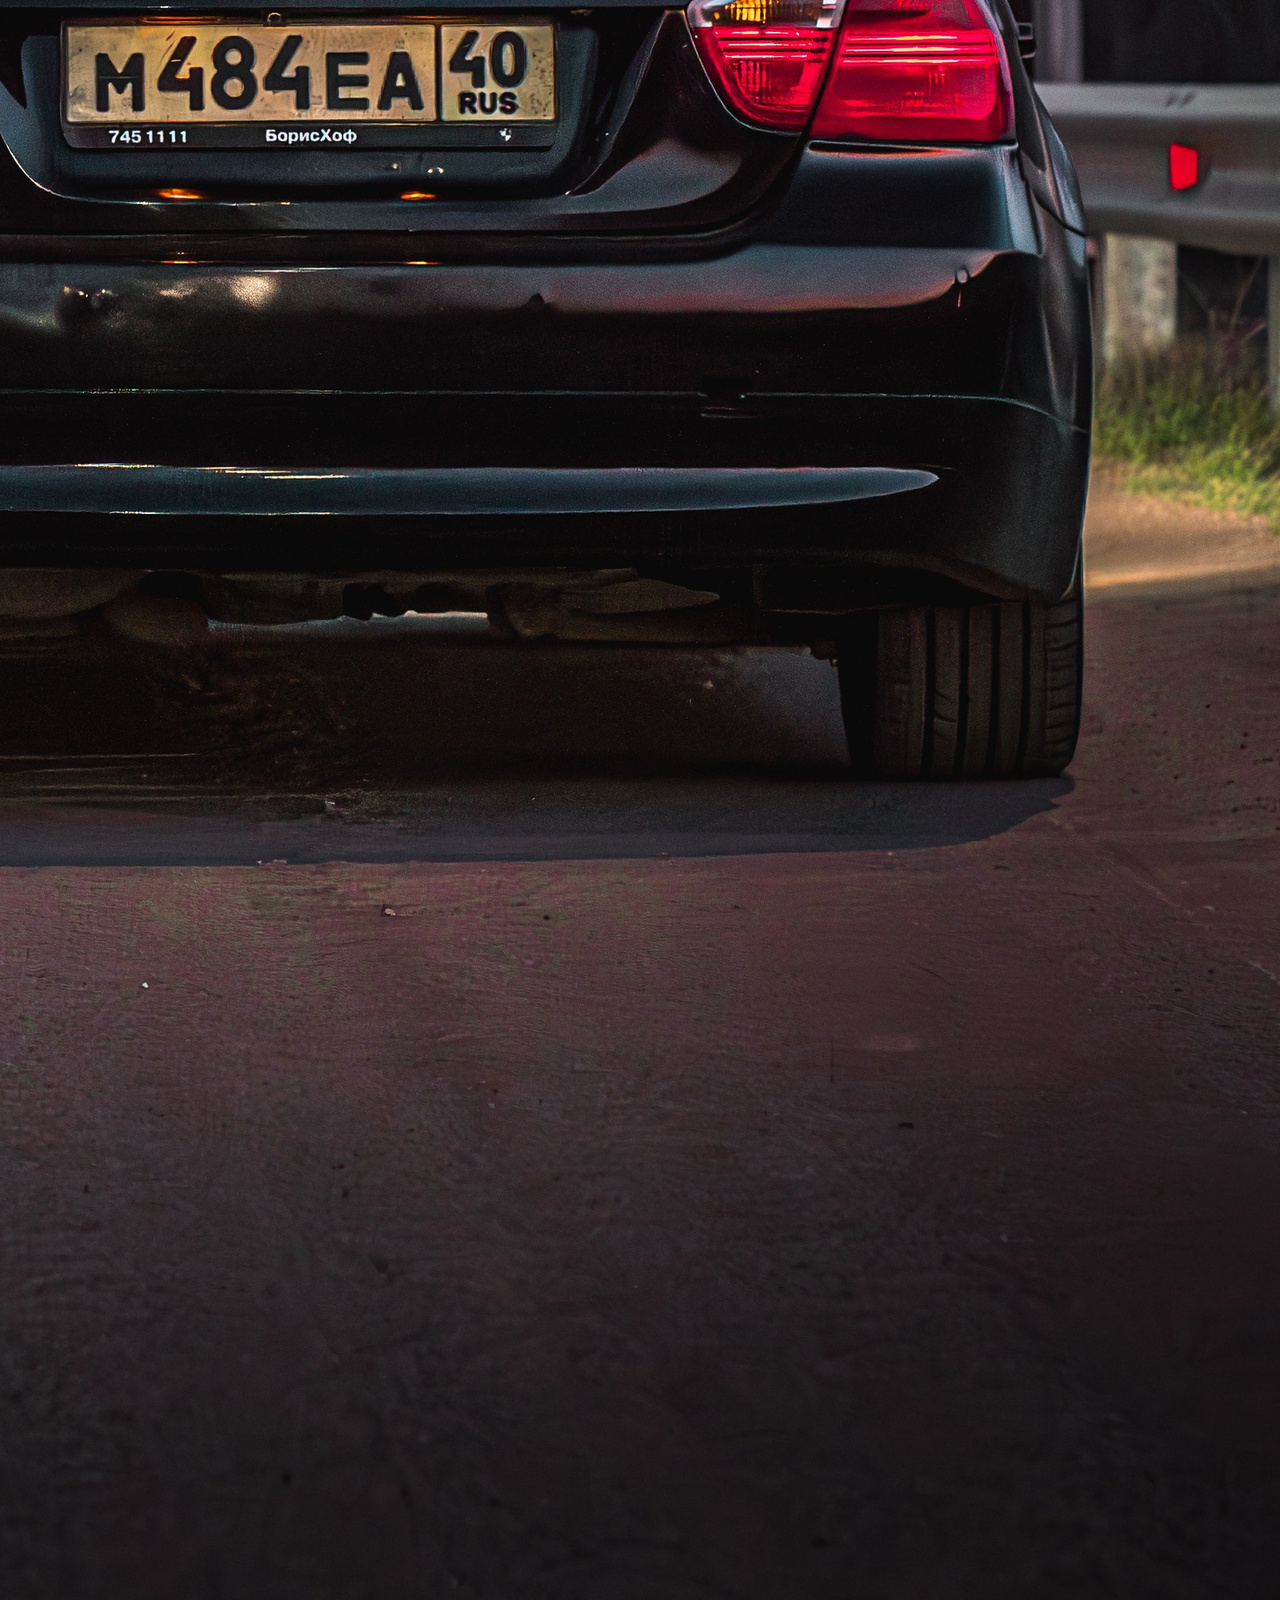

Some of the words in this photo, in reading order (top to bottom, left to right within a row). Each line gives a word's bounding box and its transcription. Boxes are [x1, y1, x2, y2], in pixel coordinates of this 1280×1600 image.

[449, 30, 528, 88] 40
[458, 92, 518, 115] RUS
[265, 128, 358, 145] БорисХоф
